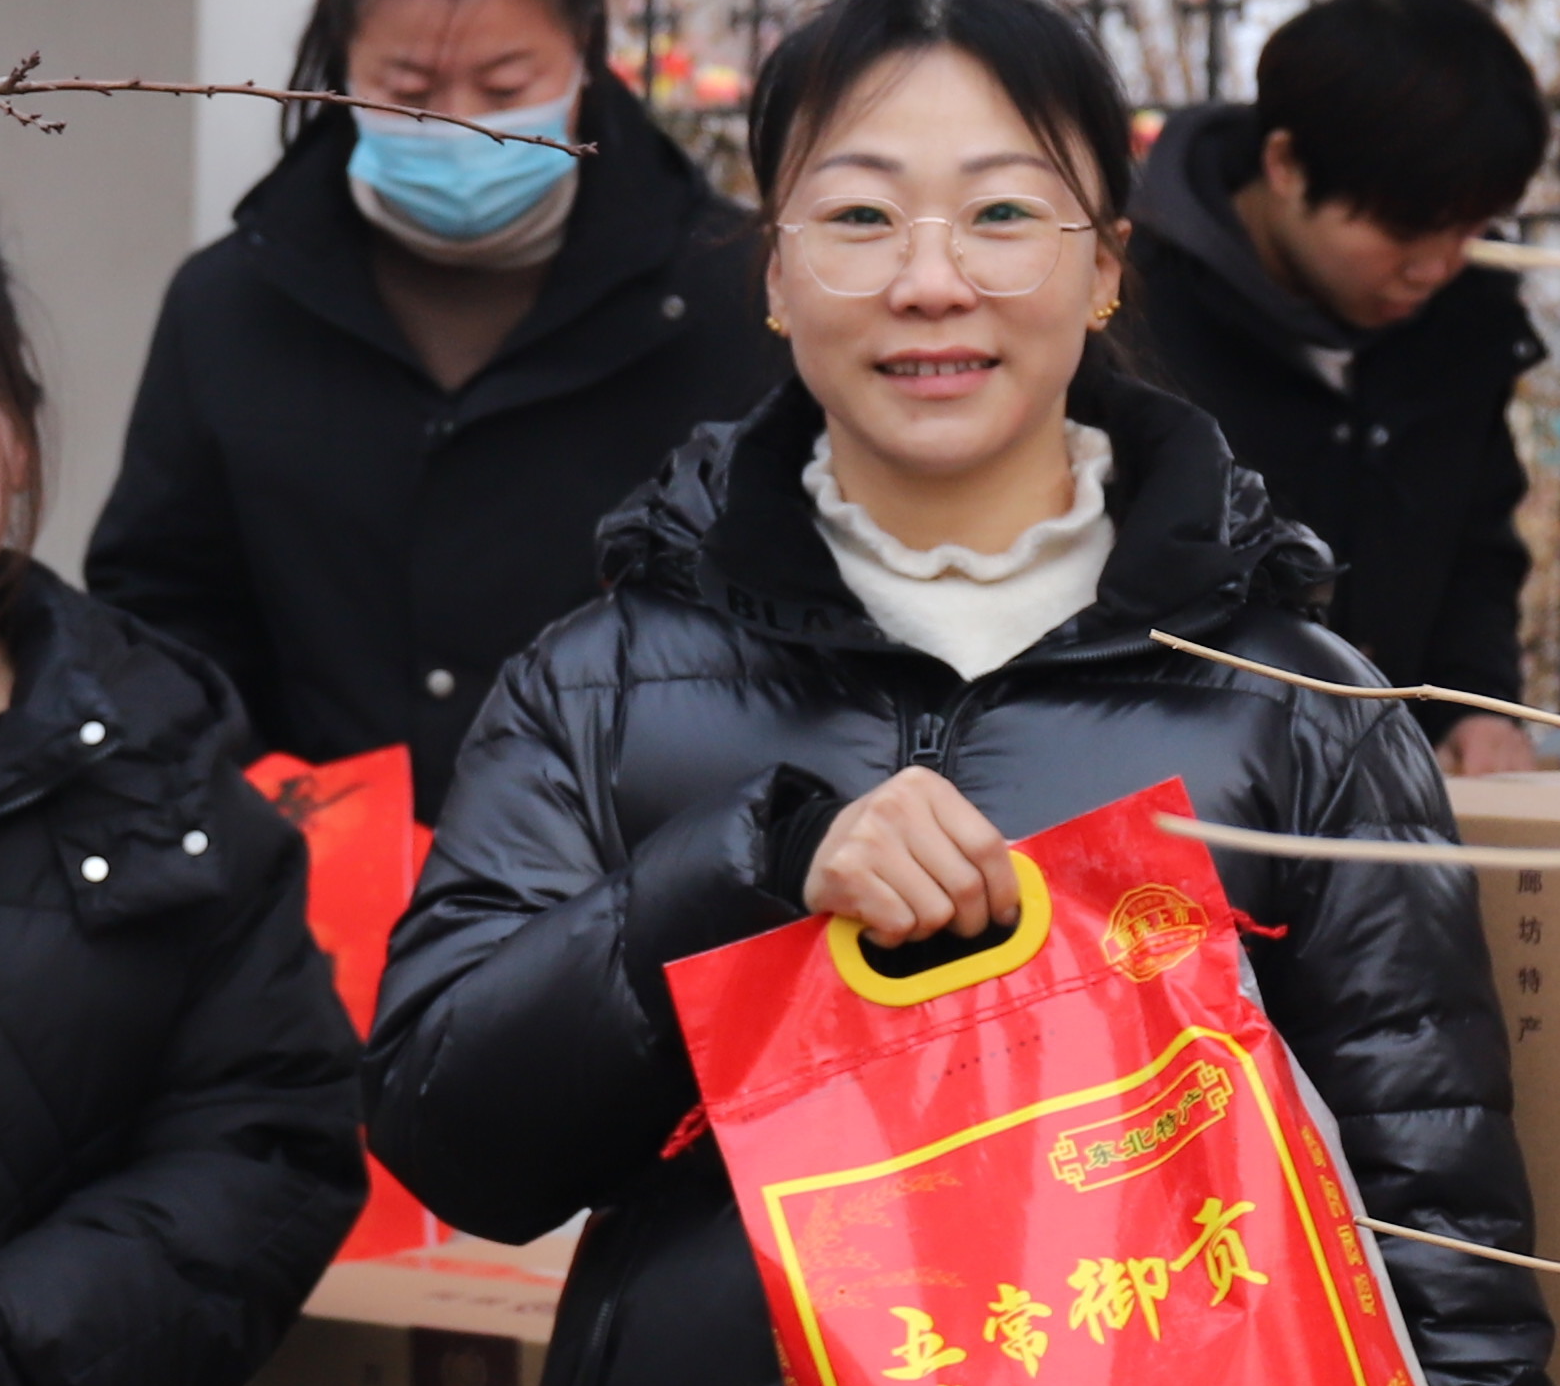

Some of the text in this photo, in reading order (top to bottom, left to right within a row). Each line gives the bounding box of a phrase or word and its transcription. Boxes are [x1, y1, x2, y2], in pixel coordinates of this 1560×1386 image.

[1084, 1087, 1205, 1171] 东北特产
[881, 1197, 1269, 1380] 五常御贡
